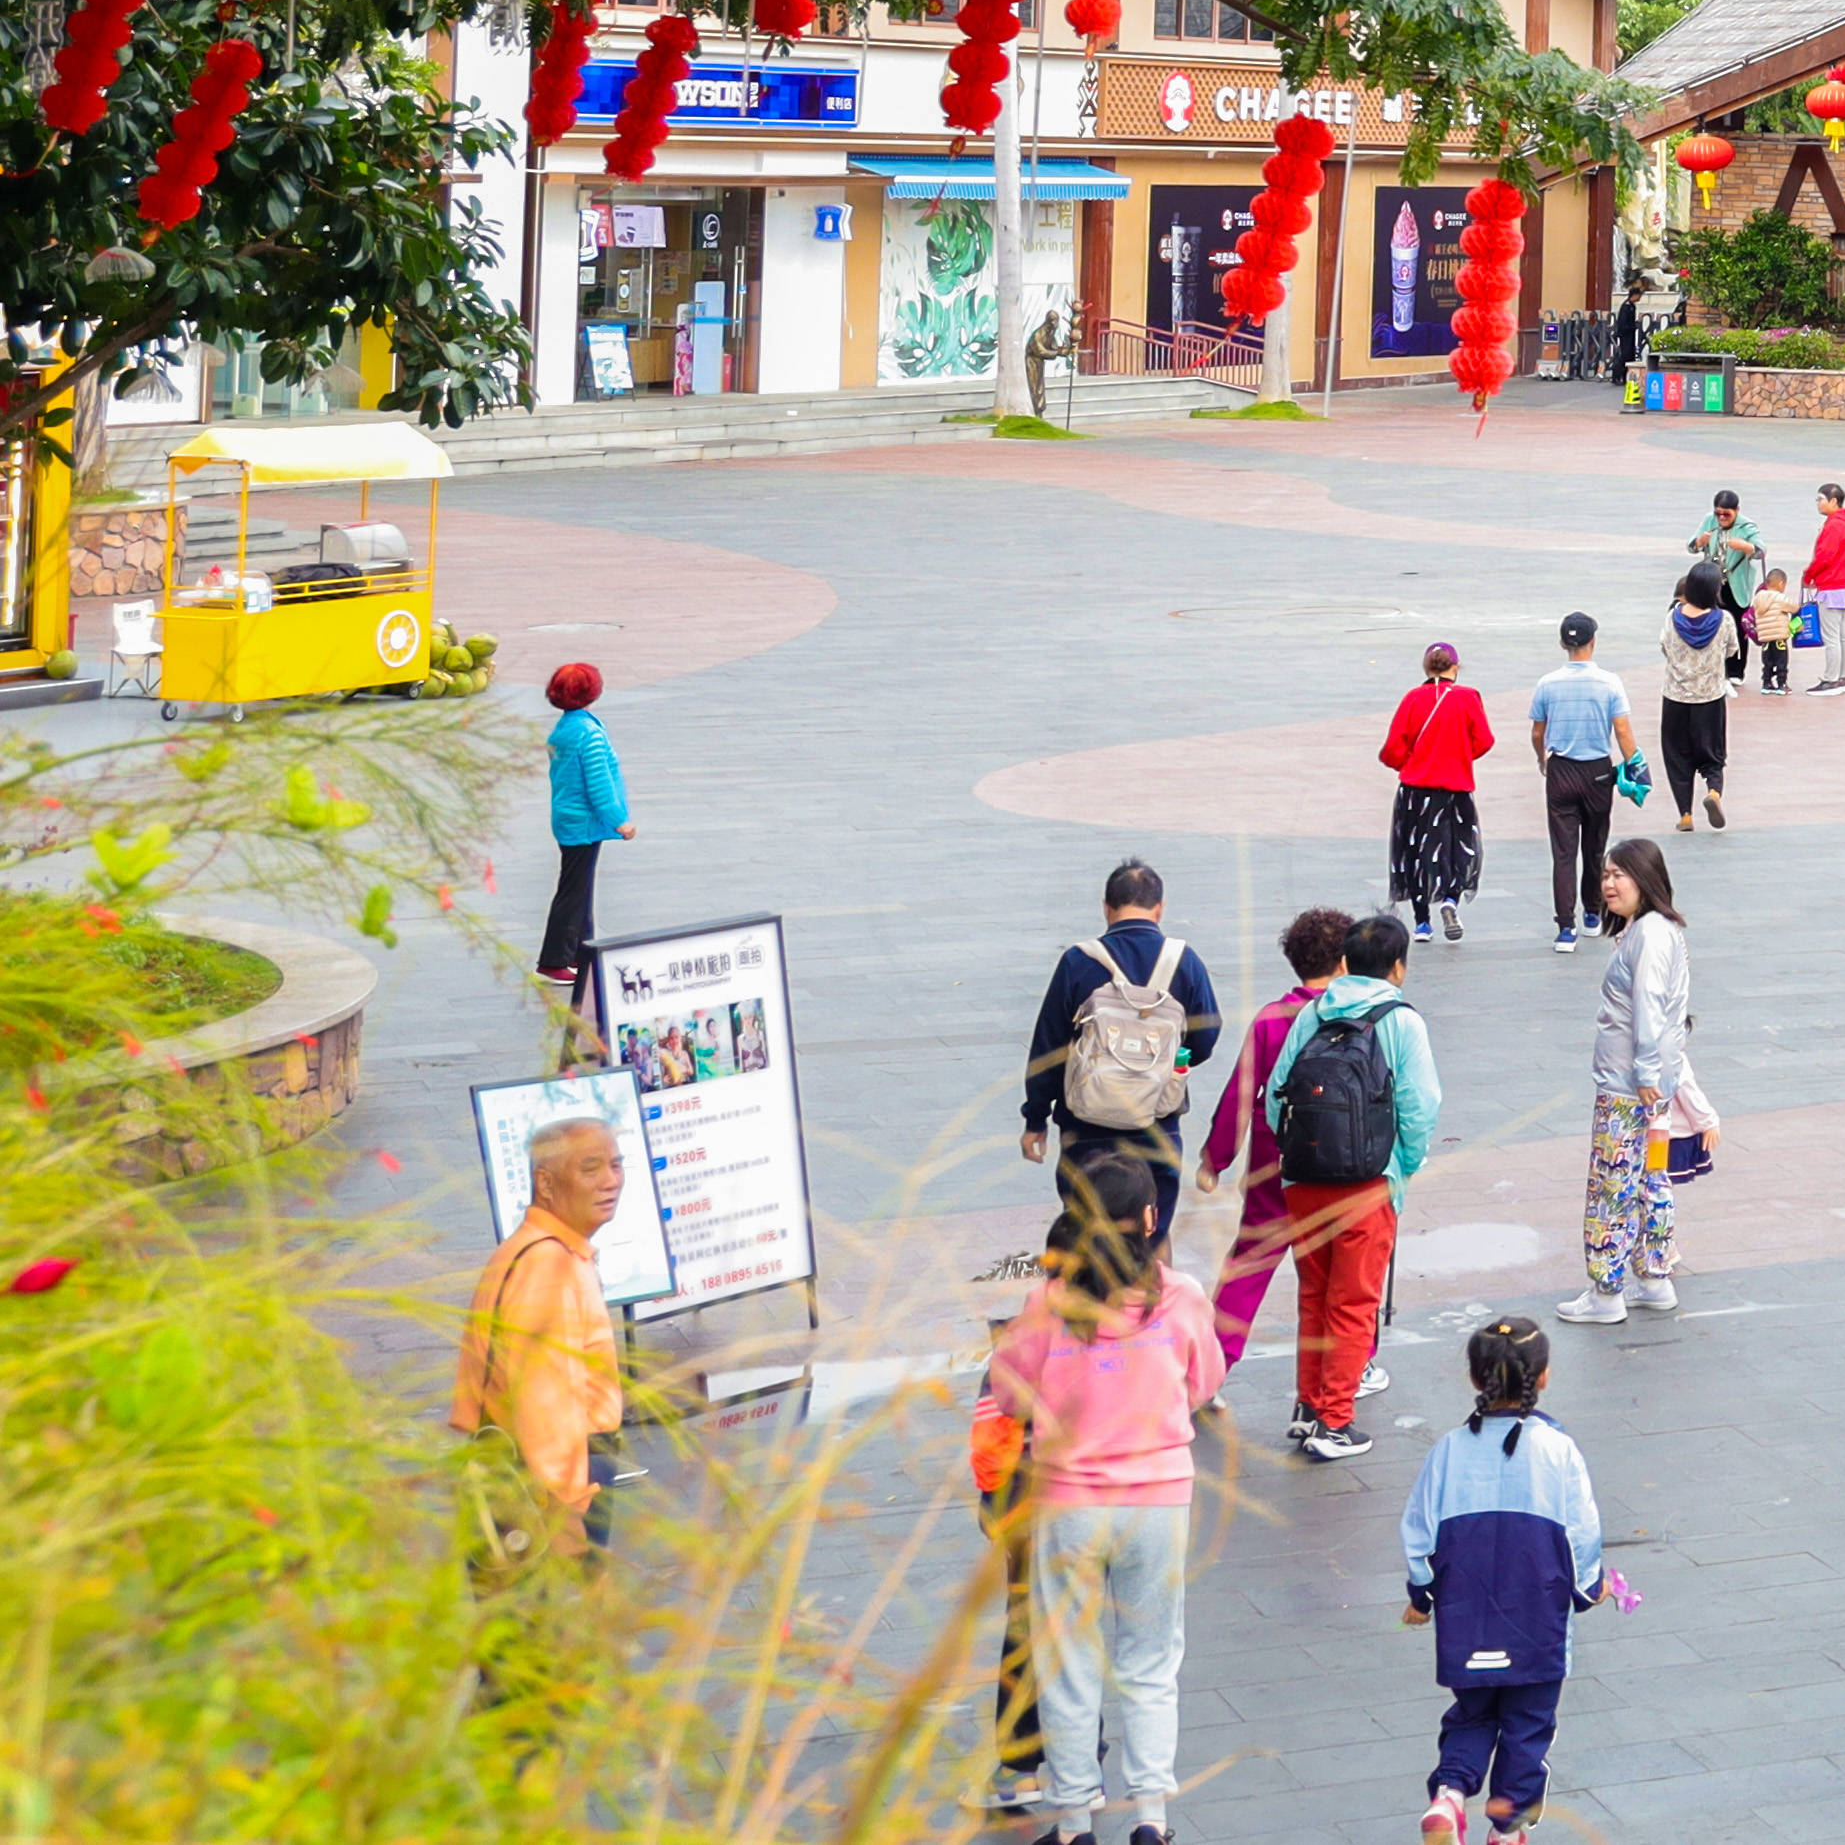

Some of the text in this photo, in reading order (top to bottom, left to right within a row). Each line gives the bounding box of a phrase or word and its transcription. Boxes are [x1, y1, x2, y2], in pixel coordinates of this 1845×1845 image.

[672, 79, 748, 108] WSON
[656, 951, 731, 983] 一见钟情旅拍
